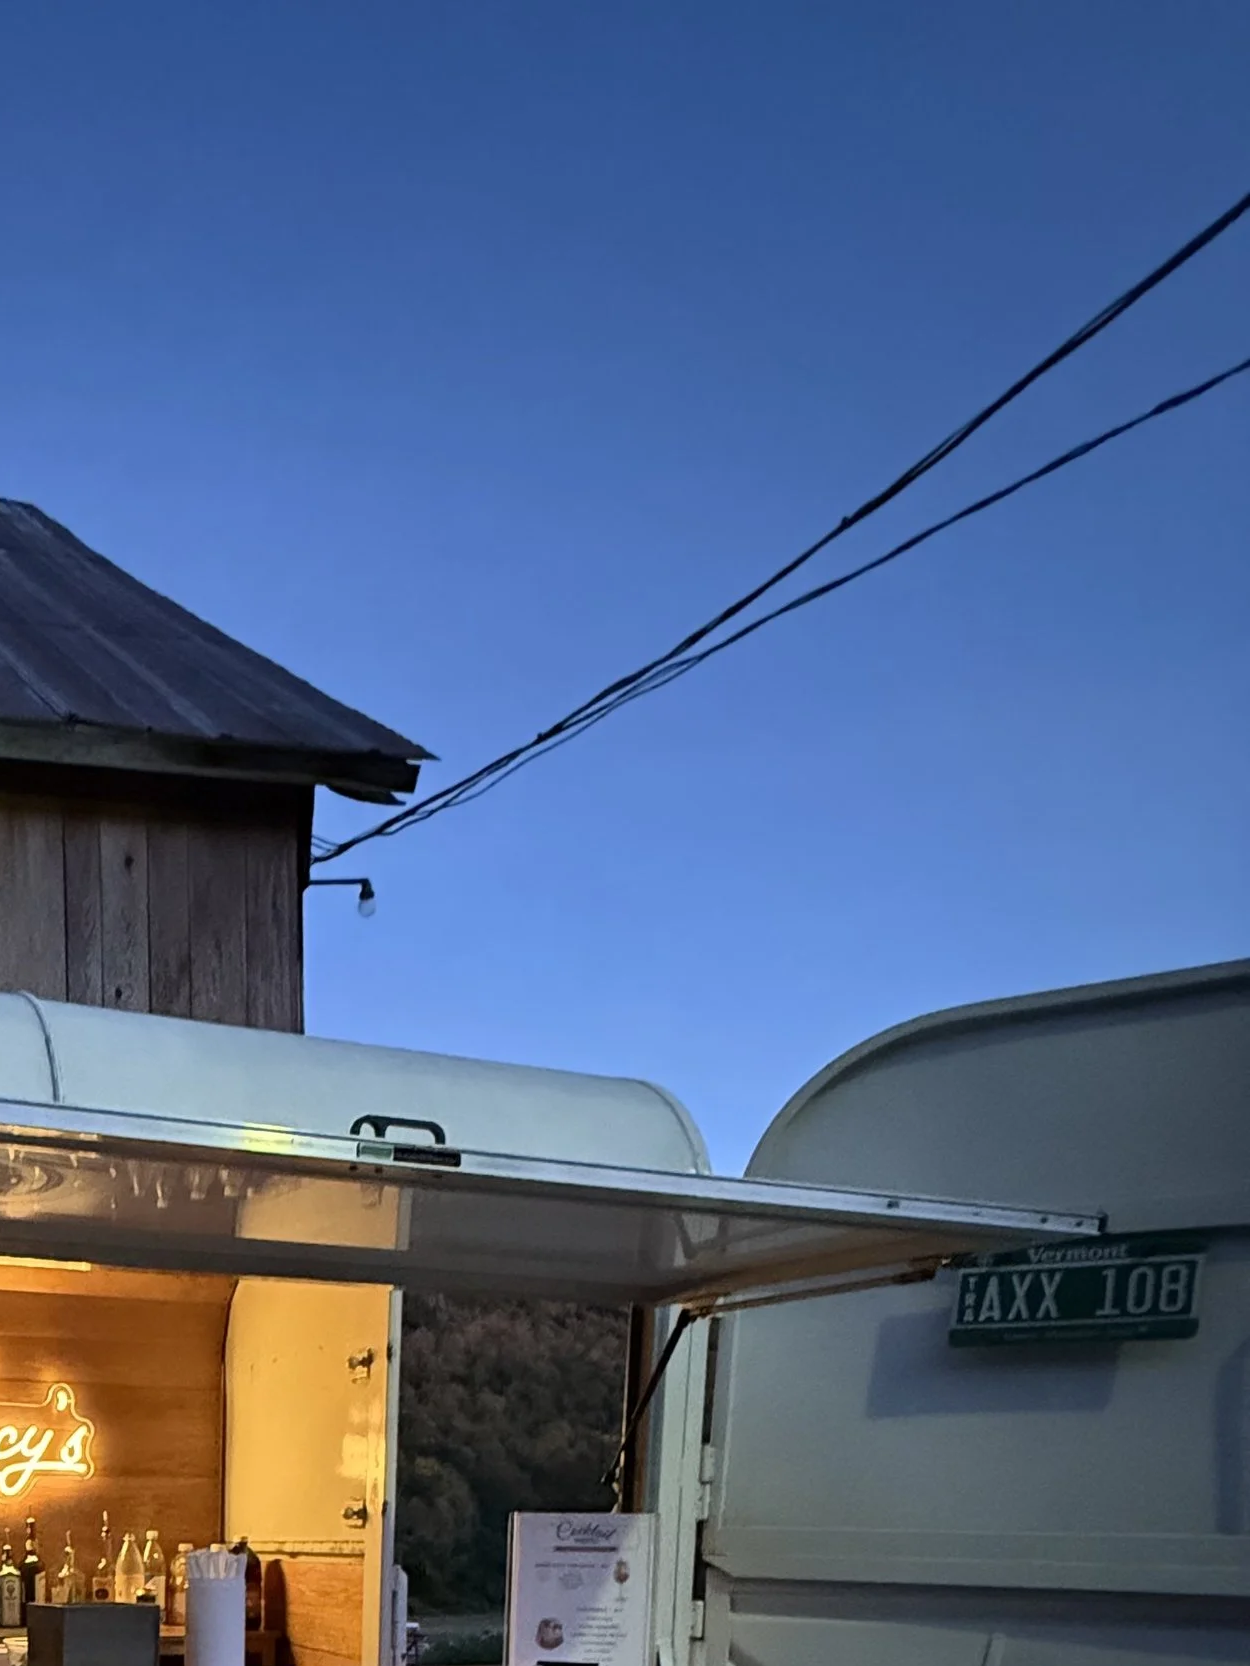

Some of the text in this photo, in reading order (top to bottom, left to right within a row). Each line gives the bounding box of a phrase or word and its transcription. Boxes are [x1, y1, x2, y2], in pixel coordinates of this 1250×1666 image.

[1029, 1243, 1129, 1264] Vermont
[978, 1264, 1191, 1323] AXX 108
